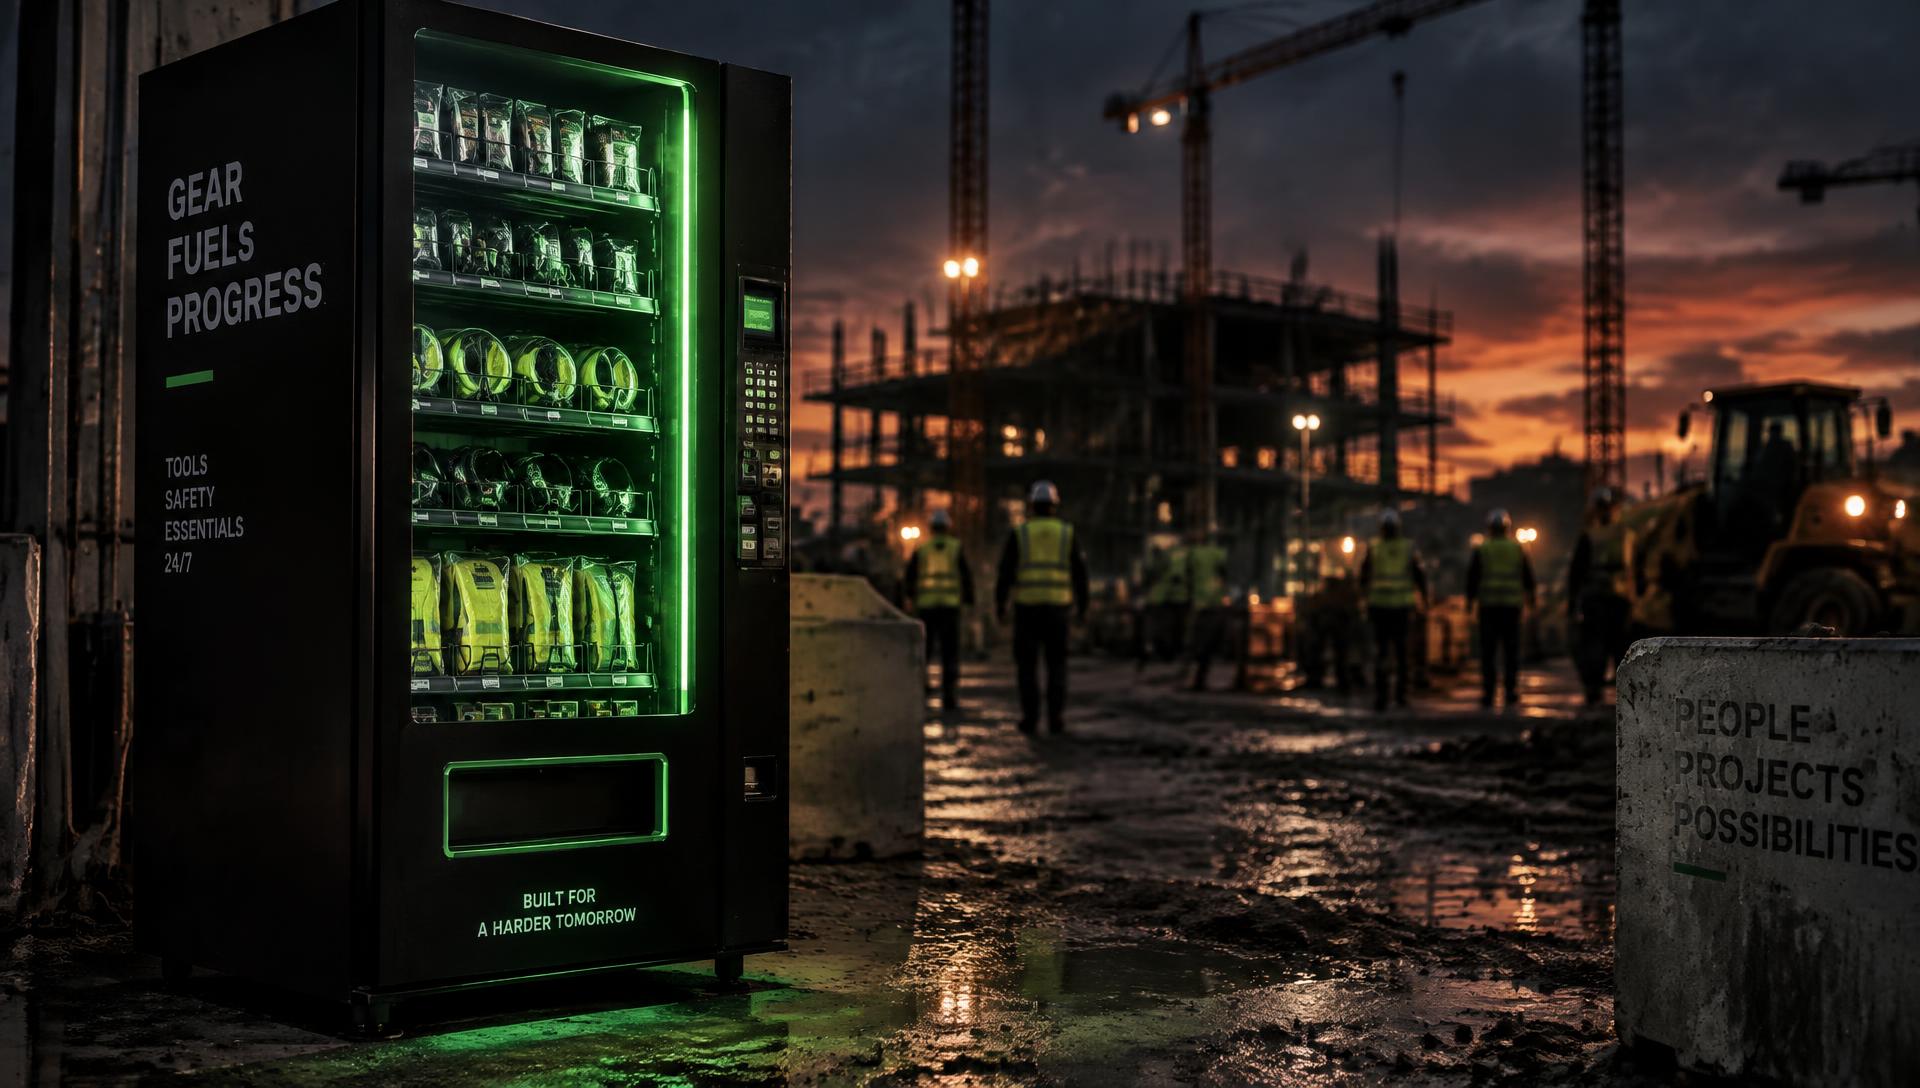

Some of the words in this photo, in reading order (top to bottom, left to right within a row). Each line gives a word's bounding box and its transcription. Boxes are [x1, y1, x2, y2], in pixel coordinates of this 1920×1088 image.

[168, 160, 243, 221] GEAR
[168, 221, 255, 280] FUELS
[167, 262, 323, 338] PROGRESS
[165, 454, 208, 479] TOOLS
[165, 486, 215, 510] SAFETY
[165, 515, 244, 541] ESSENTIALS
[164, 552, 192, 574] 24/7
[1674, 697, 1811, 743] PEOPLE
[1674, 750, 1865, 806] PROJECTS
[1674, 801, 1918, 873] POSSIBILITIES
[523, 890, 565, 909] BUILT
[568, 888, 596, 904] FOR
[477, 921, 488, 938] A
[493, 915, 551, 936] HARDER
[555, 907, 637, 928] TOMORROW
